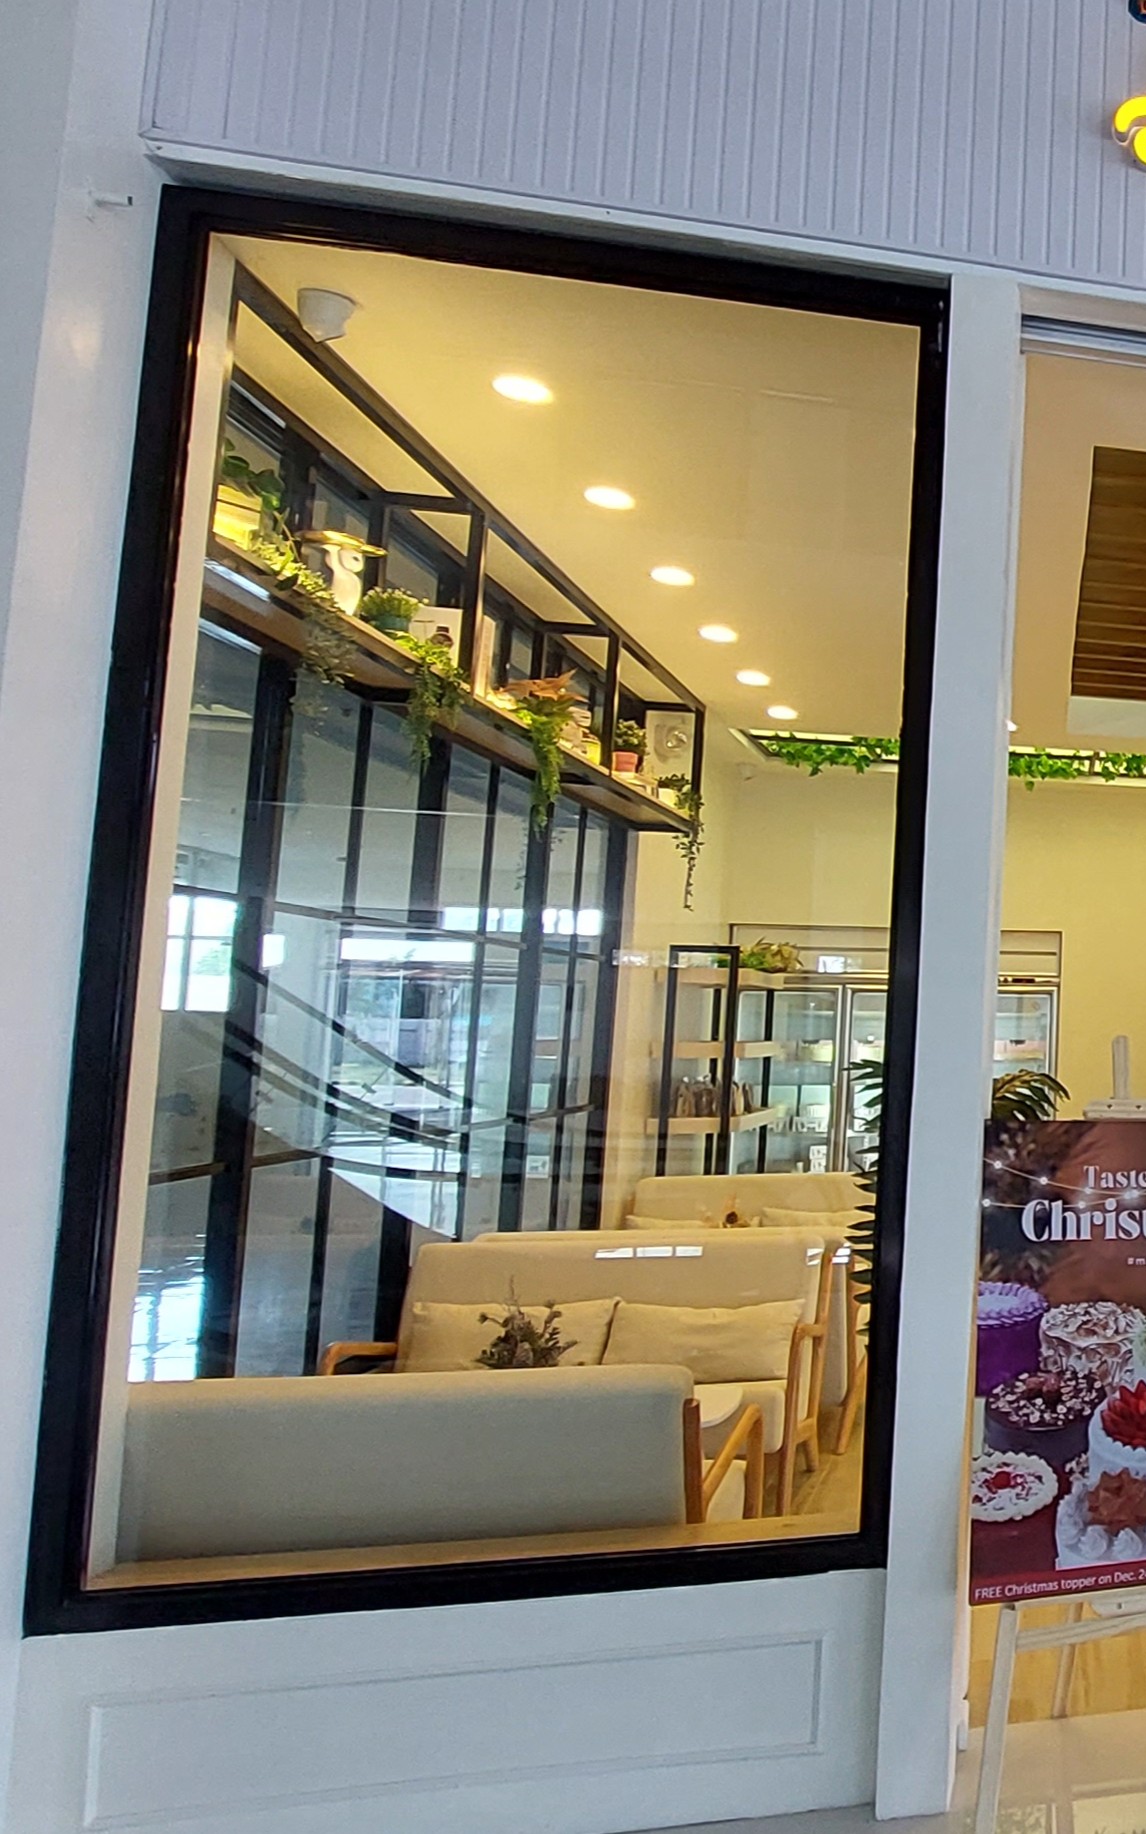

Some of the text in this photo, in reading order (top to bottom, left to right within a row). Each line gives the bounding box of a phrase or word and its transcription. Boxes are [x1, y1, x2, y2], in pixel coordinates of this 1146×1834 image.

[974, 1586, 1003, 1600] FREE
[1004, 1581, 1059, 1597] Christmas
[1061, 1576, 1096, 1590] topper
[1098, 1574, 1112, 1585] on
[1114, 1571, 1136, 1583] Dec.
